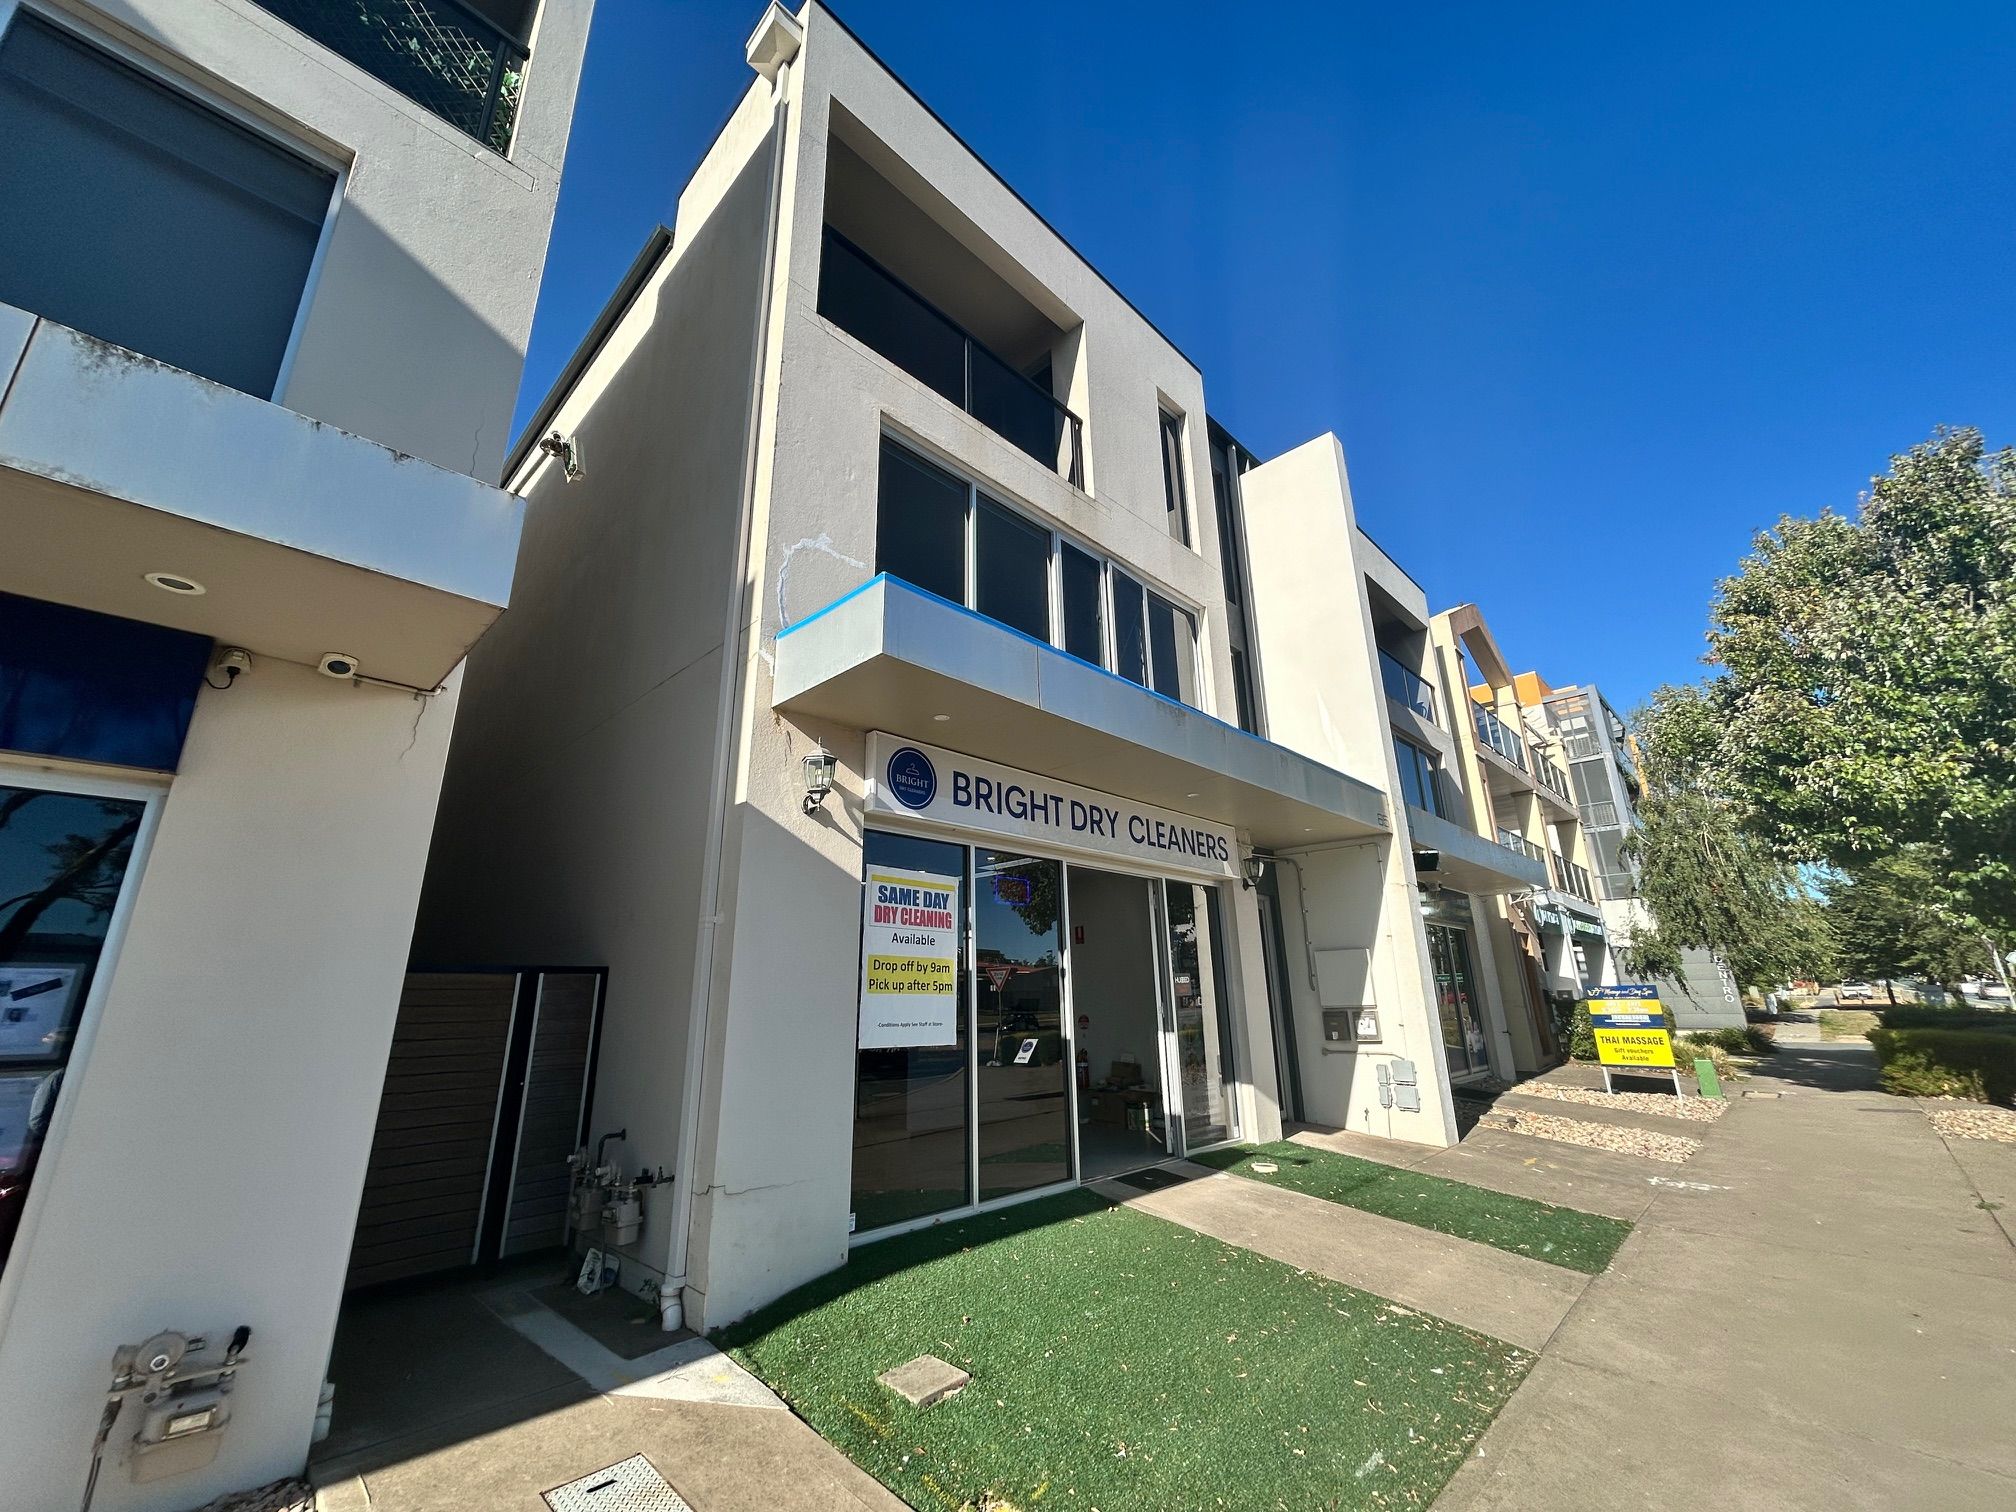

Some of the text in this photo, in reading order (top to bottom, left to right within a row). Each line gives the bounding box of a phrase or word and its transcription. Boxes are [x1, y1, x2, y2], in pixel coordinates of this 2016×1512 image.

[896, 774, 928, 788] BRIGHT
[953, 770, 1229, 861] BRIGHT DRY CLEANERS
[878, 885, 950, 910] SAME DAY
[874, 904, 952, 929] DRY CLEANING
[891, 932, 936, 946] Available
[873, 959, 950, 974] Drop off by 9am
[868, 978, 953, 994] Pick up after 5pm
[1600, 1036, 1665, 1045] THAI MASSAGE
